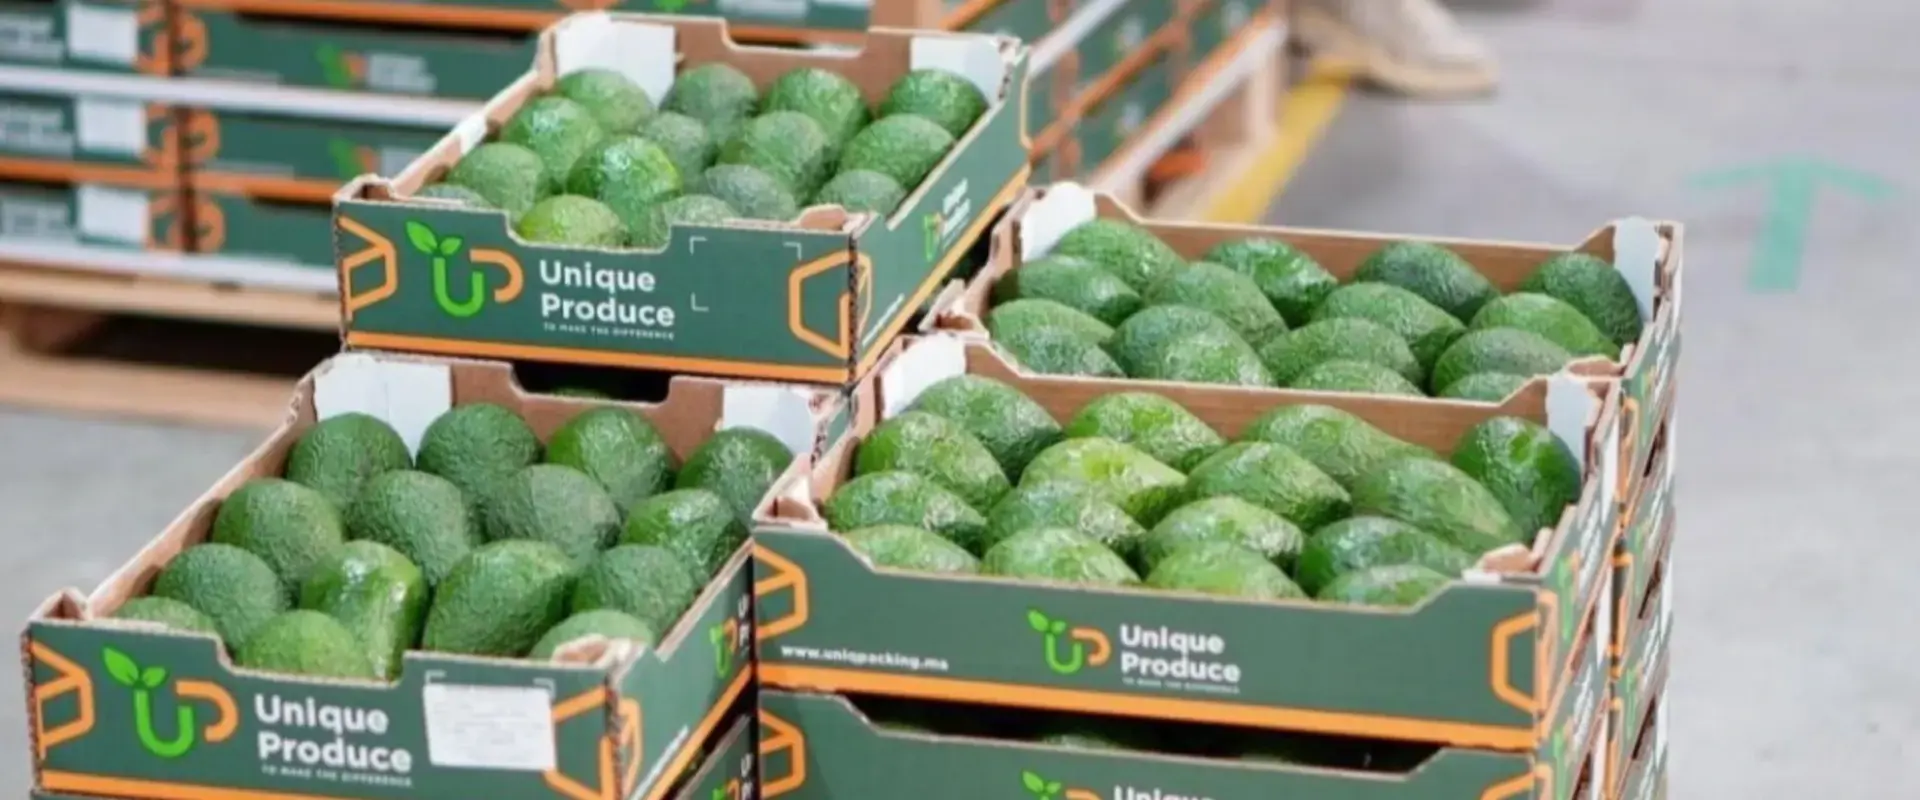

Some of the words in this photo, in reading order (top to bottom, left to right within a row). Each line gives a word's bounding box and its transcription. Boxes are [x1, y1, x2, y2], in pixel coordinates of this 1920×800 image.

[539, 259, 656, 293] Unique
[541, 293, 676, 327] Produce
[1119, 624, 1225, 654] Unique
[1120, 652, 1242, 683] Produce
[255, 693, 389, 734] Unique
[258, 731, 413, 773] Produce
